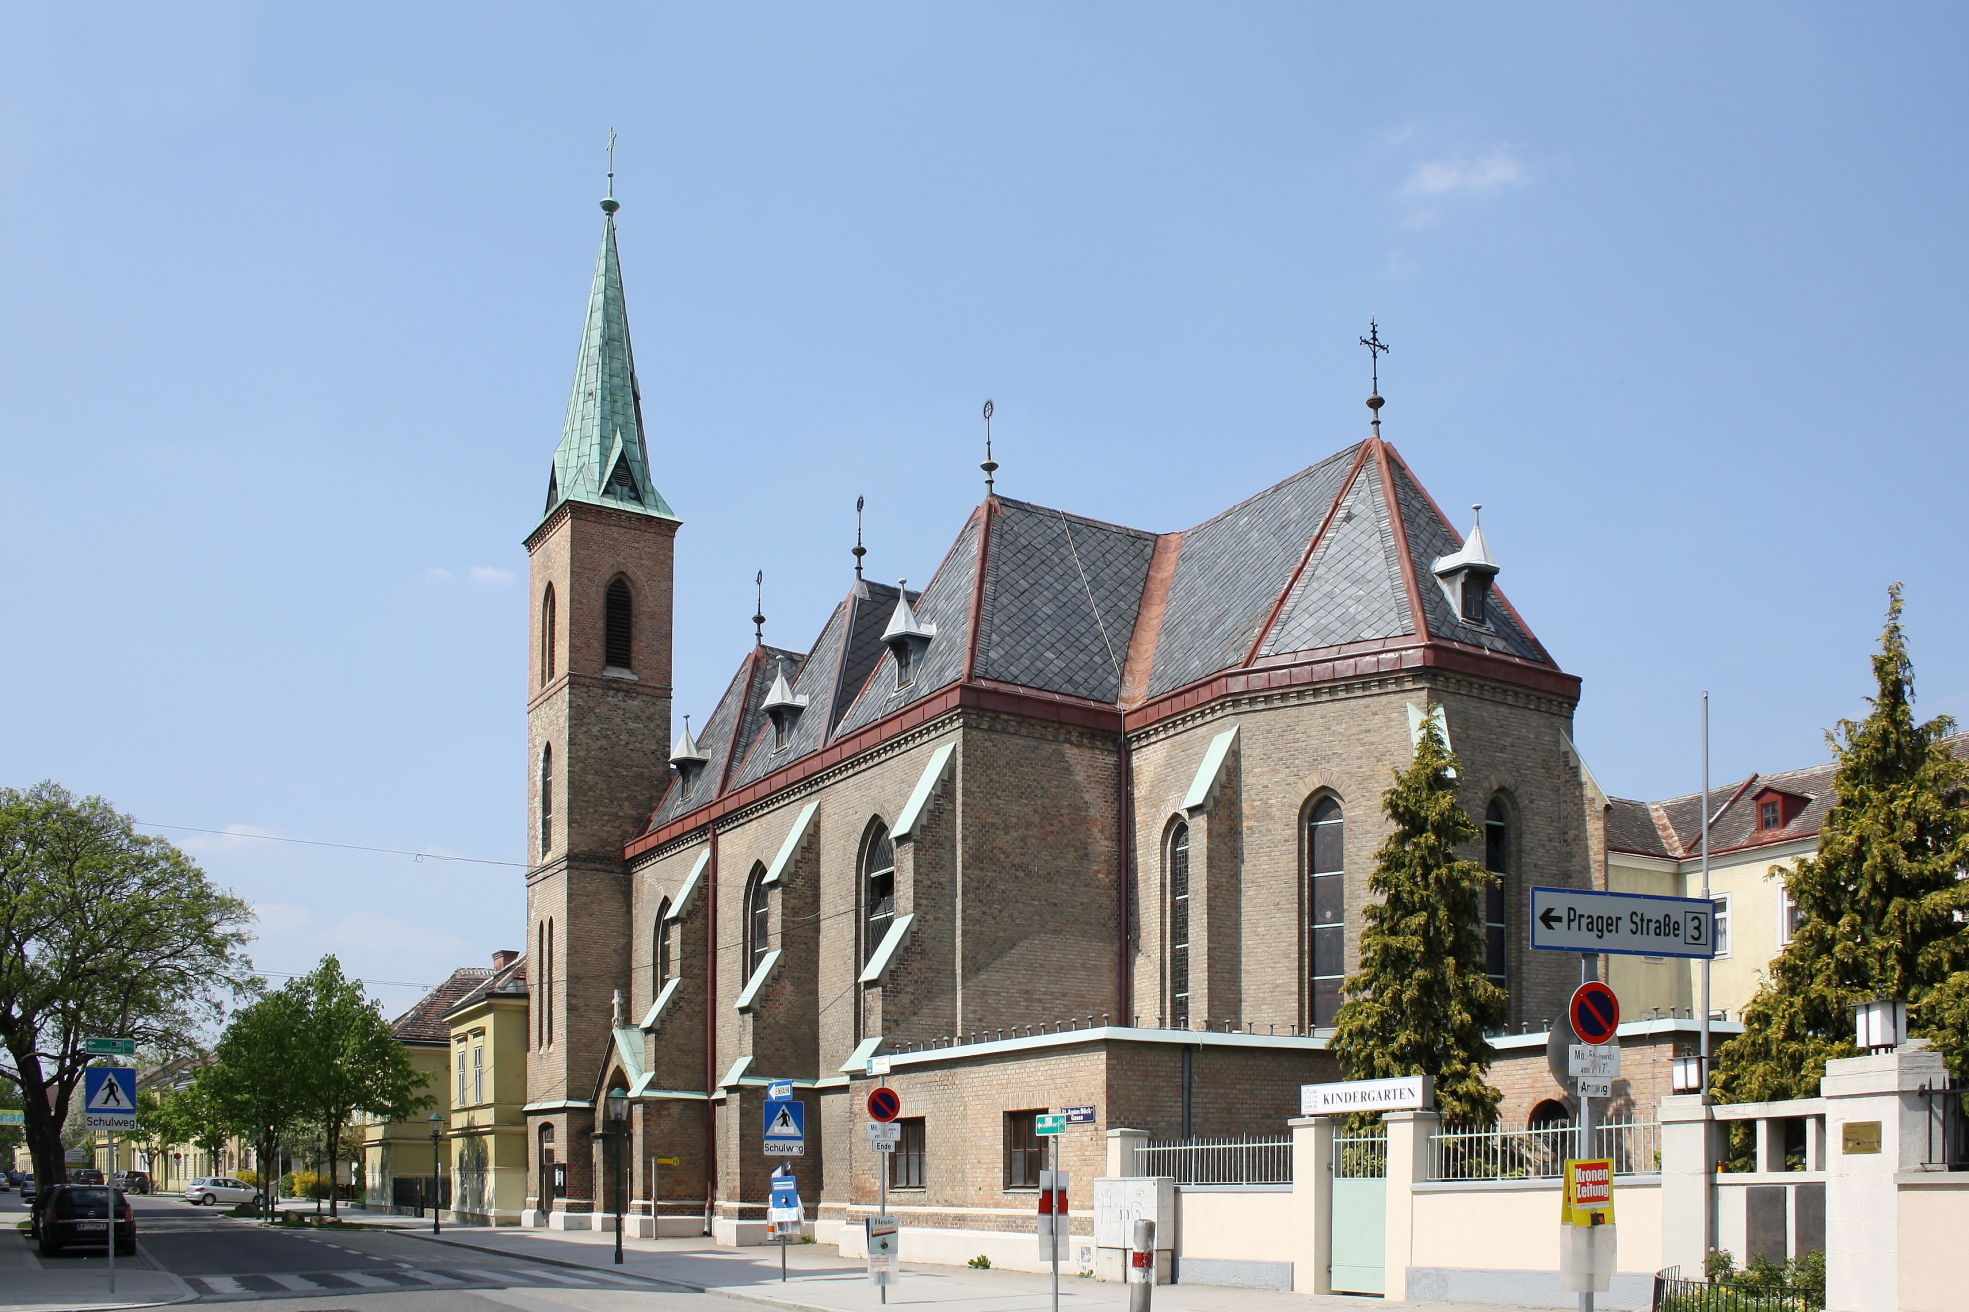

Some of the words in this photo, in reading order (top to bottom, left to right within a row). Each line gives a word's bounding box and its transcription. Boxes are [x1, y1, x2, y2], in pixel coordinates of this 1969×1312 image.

[1567, 906, 1622, 939] Prager
[1629, 910, 1680, 938] Straße
[1690, 915, 1702, 942] 3
[1323, 1086, 1416, 1105] KINDERGARTEN
[86, 1116, 135, 1129] Schulweg
[764, 1143, 804, 1154] Schulwg
[1575, 1168, 1609, 1183] Kronen
[1576, 1182, 1609, 1199] Zeitung
